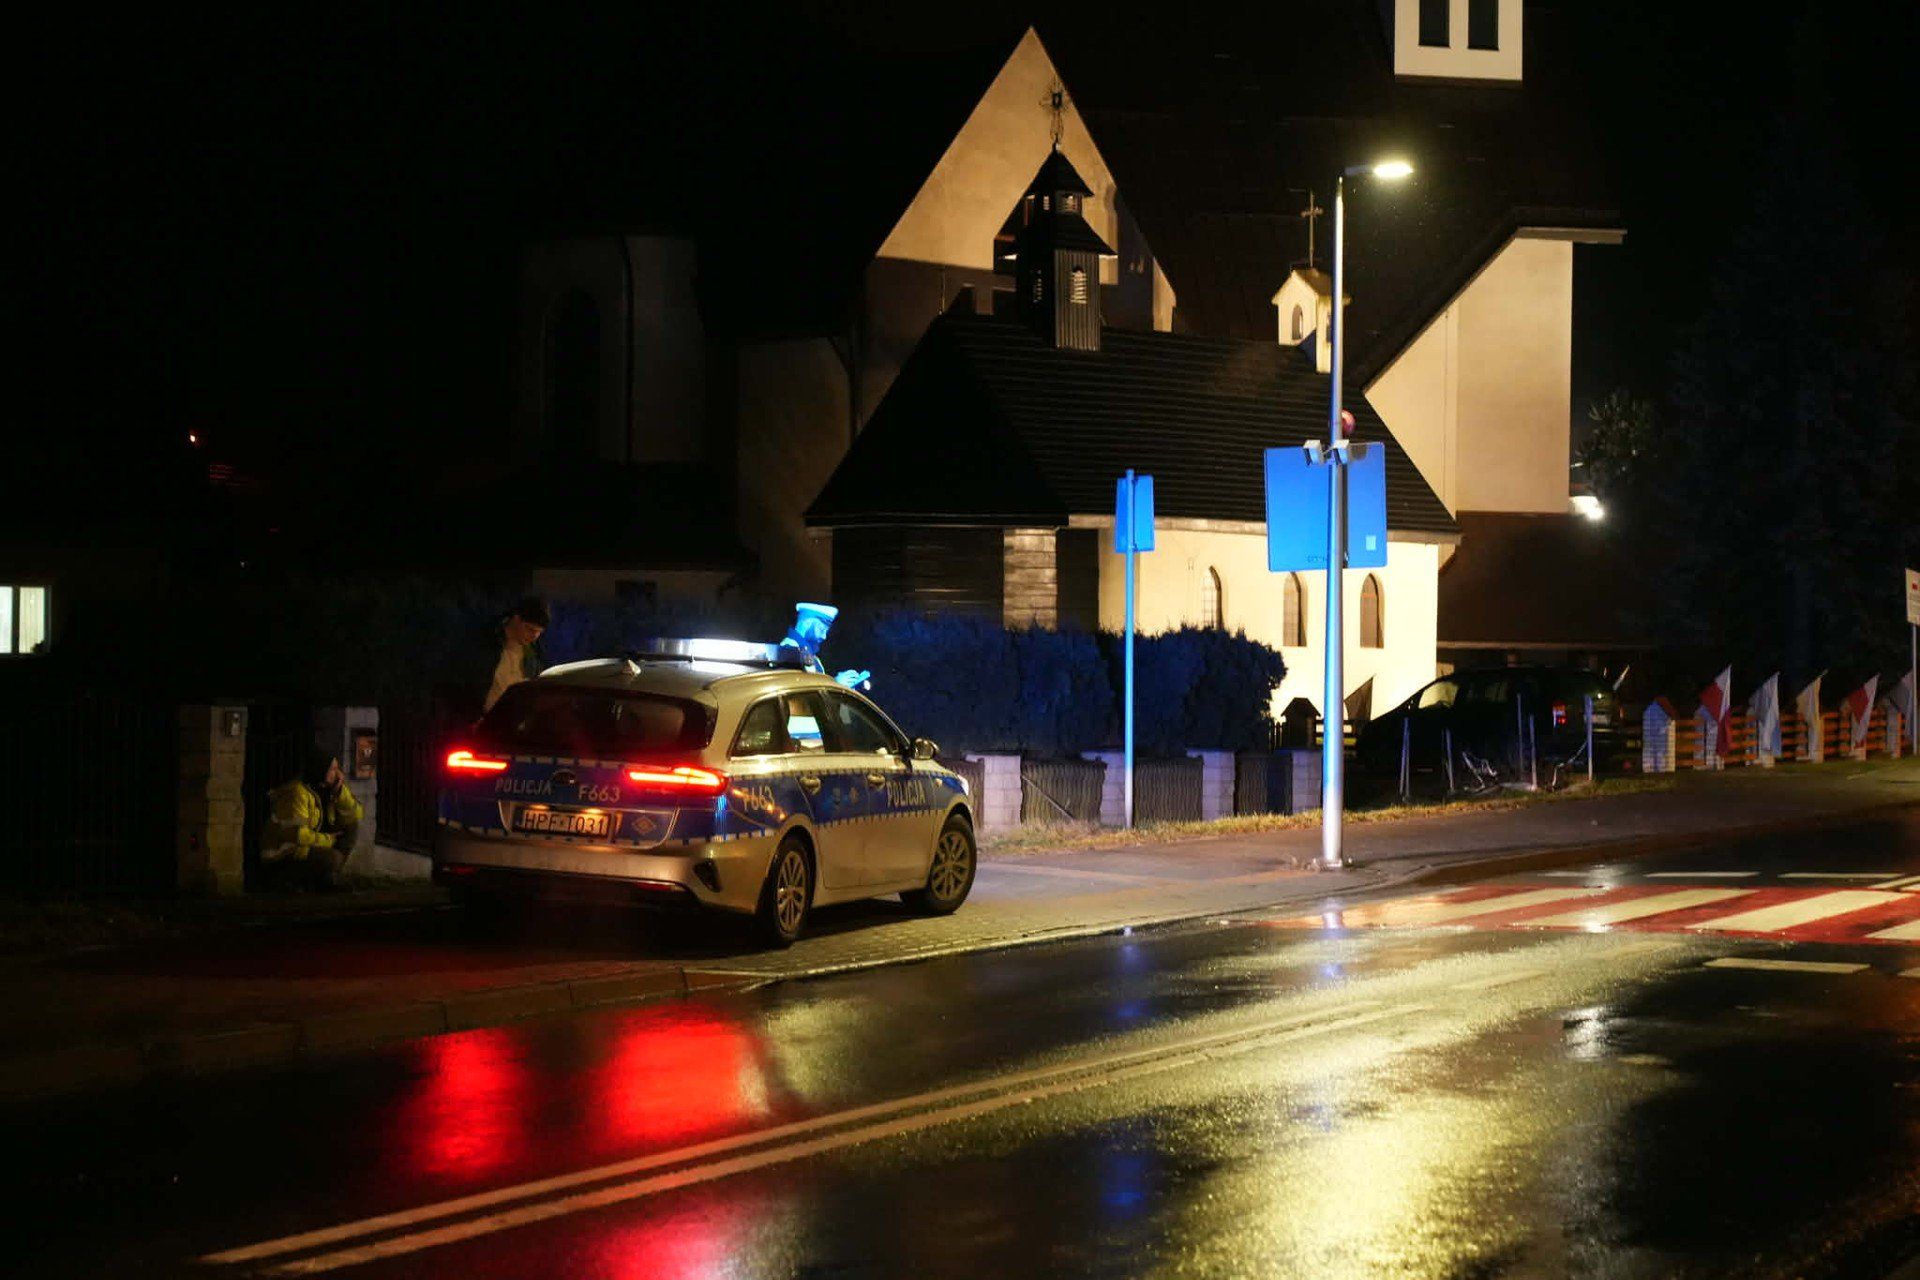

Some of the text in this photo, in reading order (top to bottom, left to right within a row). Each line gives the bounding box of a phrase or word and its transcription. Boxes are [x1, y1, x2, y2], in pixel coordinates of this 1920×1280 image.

[495, 778, 552, 796] POLICJA
[579, 784, 620, 804] F663
[886, 779, 926, 808] POLICJA
